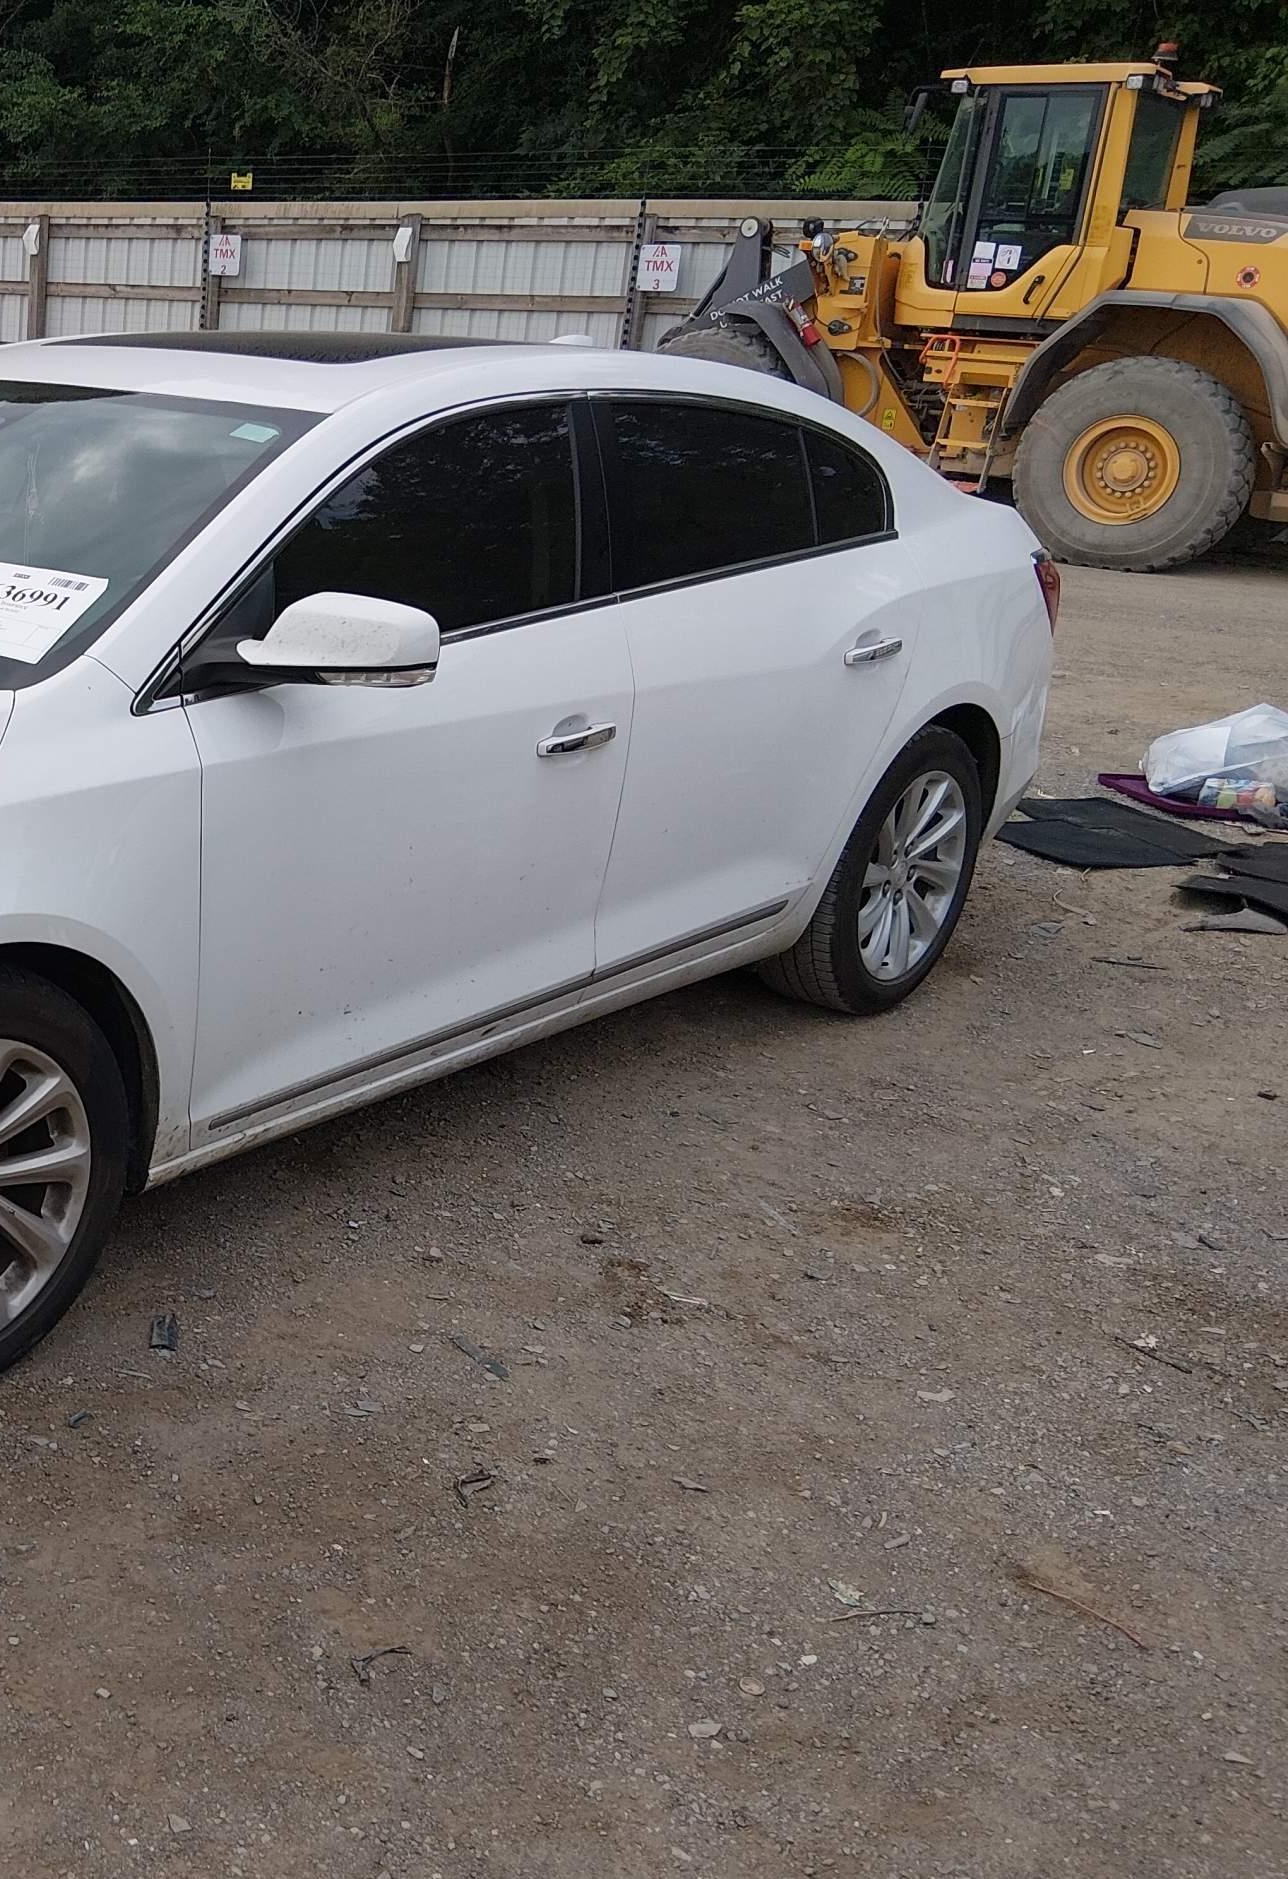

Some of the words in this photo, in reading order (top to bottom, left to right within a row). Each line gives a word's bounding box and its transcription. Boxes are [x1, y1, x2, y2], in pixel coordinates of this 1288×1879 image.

[1196, 222, 1277, 238] VOLVO
[214, 248, 235, 259] TMX
[220, 265, 227, 275] 2
[644, 260, 674, 272] TMX
[652, 279, 660, 290] 3
[752, 276, 784, 298] WALK
[760, 289, 783, 304] AST
